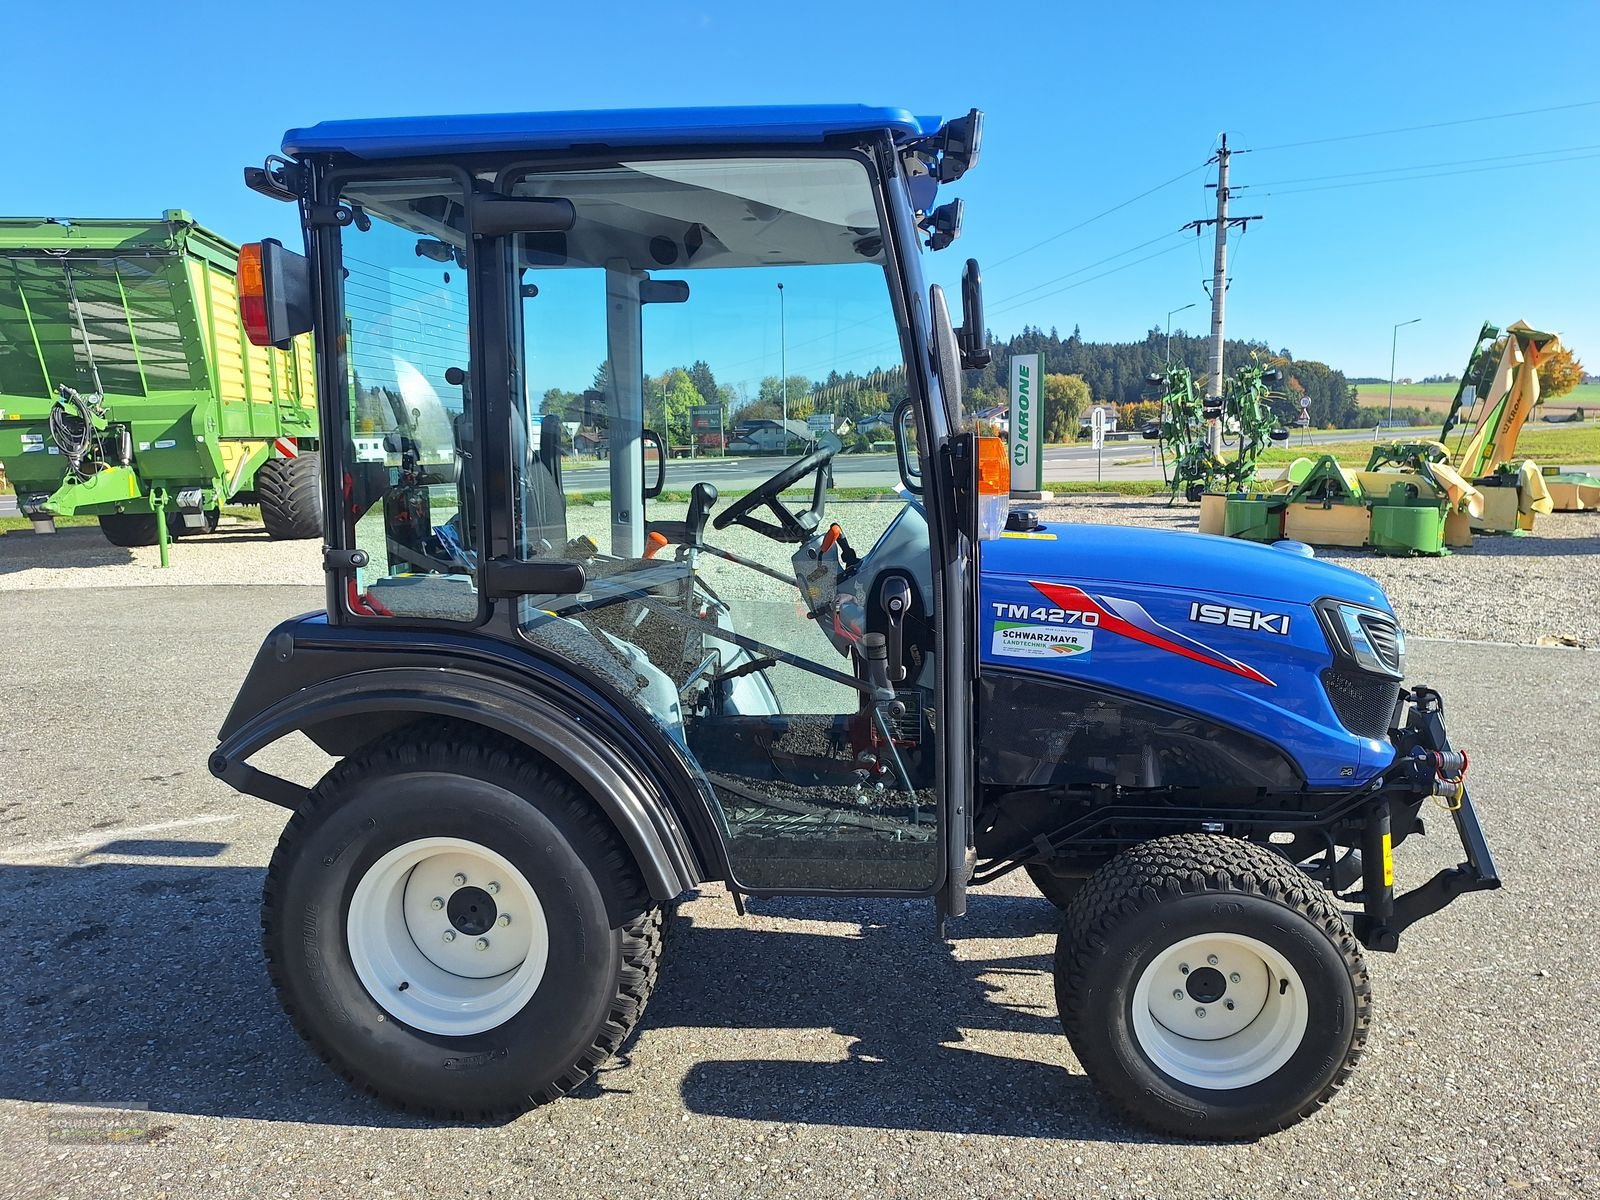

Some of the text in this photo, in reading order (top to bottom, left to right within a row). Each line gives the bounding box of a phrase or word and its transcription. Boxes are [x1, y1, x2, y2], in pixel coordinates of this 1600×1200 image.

[1018, 364, 1030, 441] KRONE
[1190, 602, 1290, 634] ISEKI
[1003, 630, 1078, 644] SCHWARZMAYR
[1003, 640, 1047, 649] LANDTECHNIK
